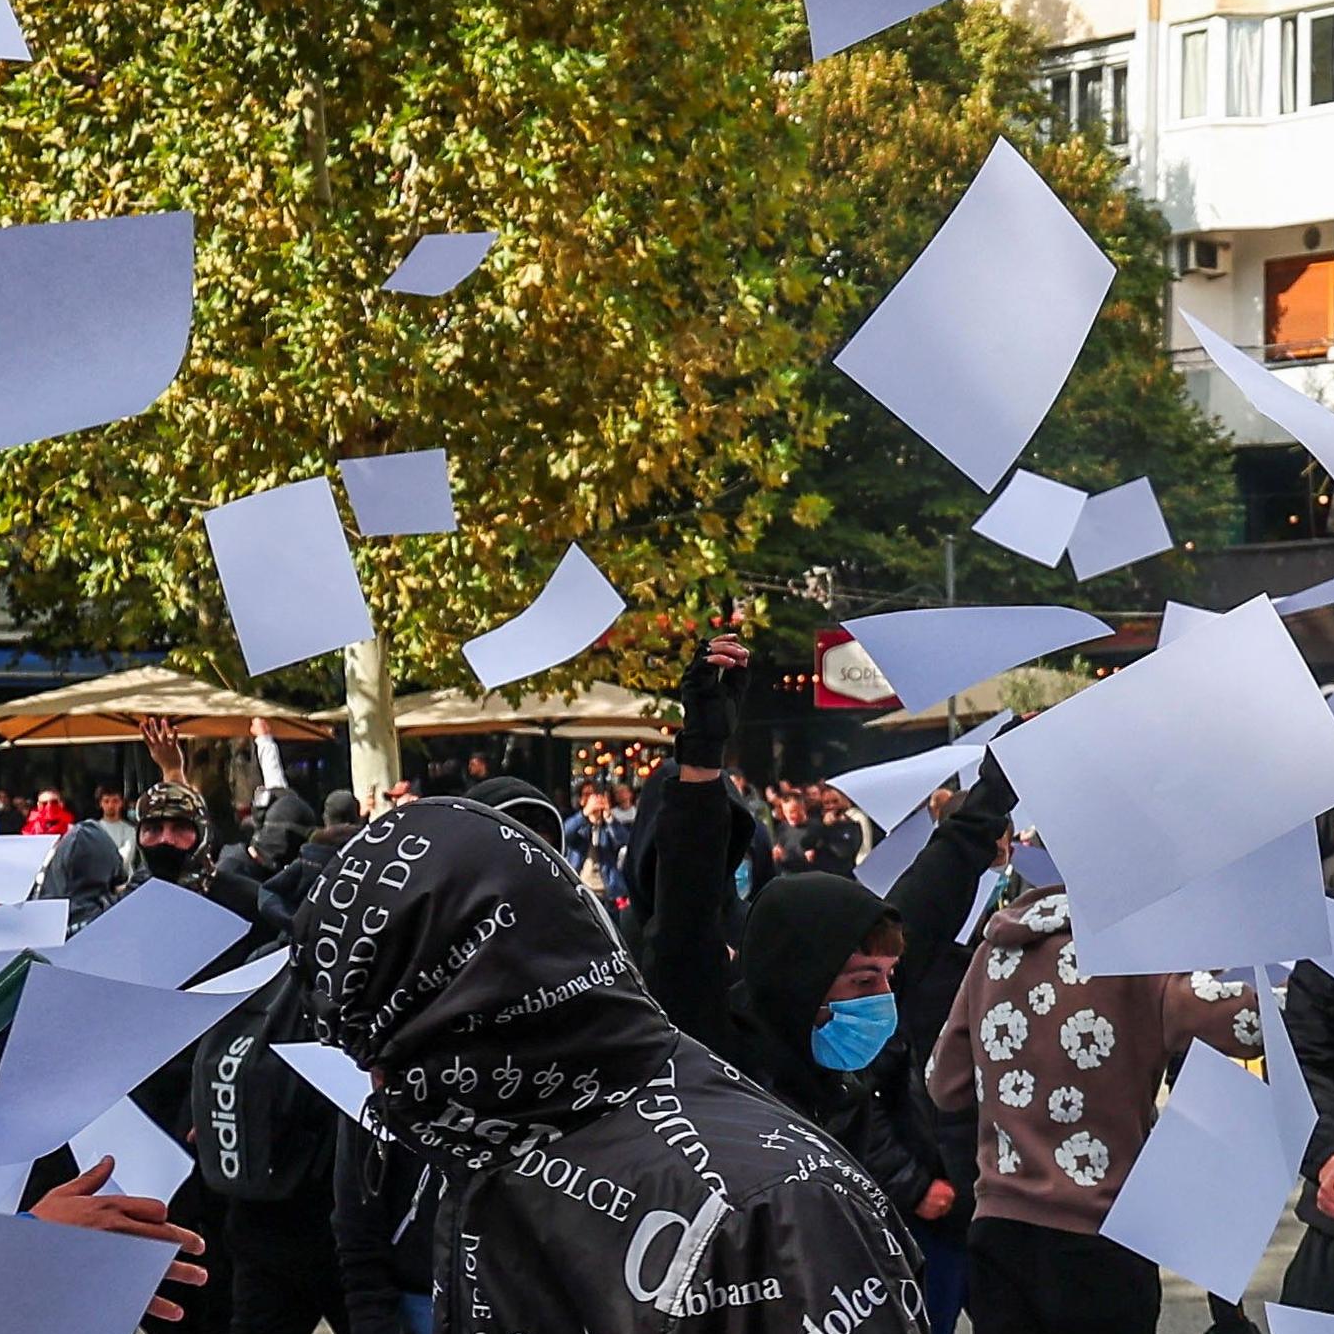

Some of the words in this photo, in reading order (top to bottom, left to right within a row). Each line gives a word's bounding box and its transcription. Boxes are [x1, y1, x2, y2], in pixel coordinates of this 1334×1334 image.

[473, 902, 517, 942] DG
[210, 1035, 255, 1180] adidas
[514, 1149, 637, 1223] DOLCE
